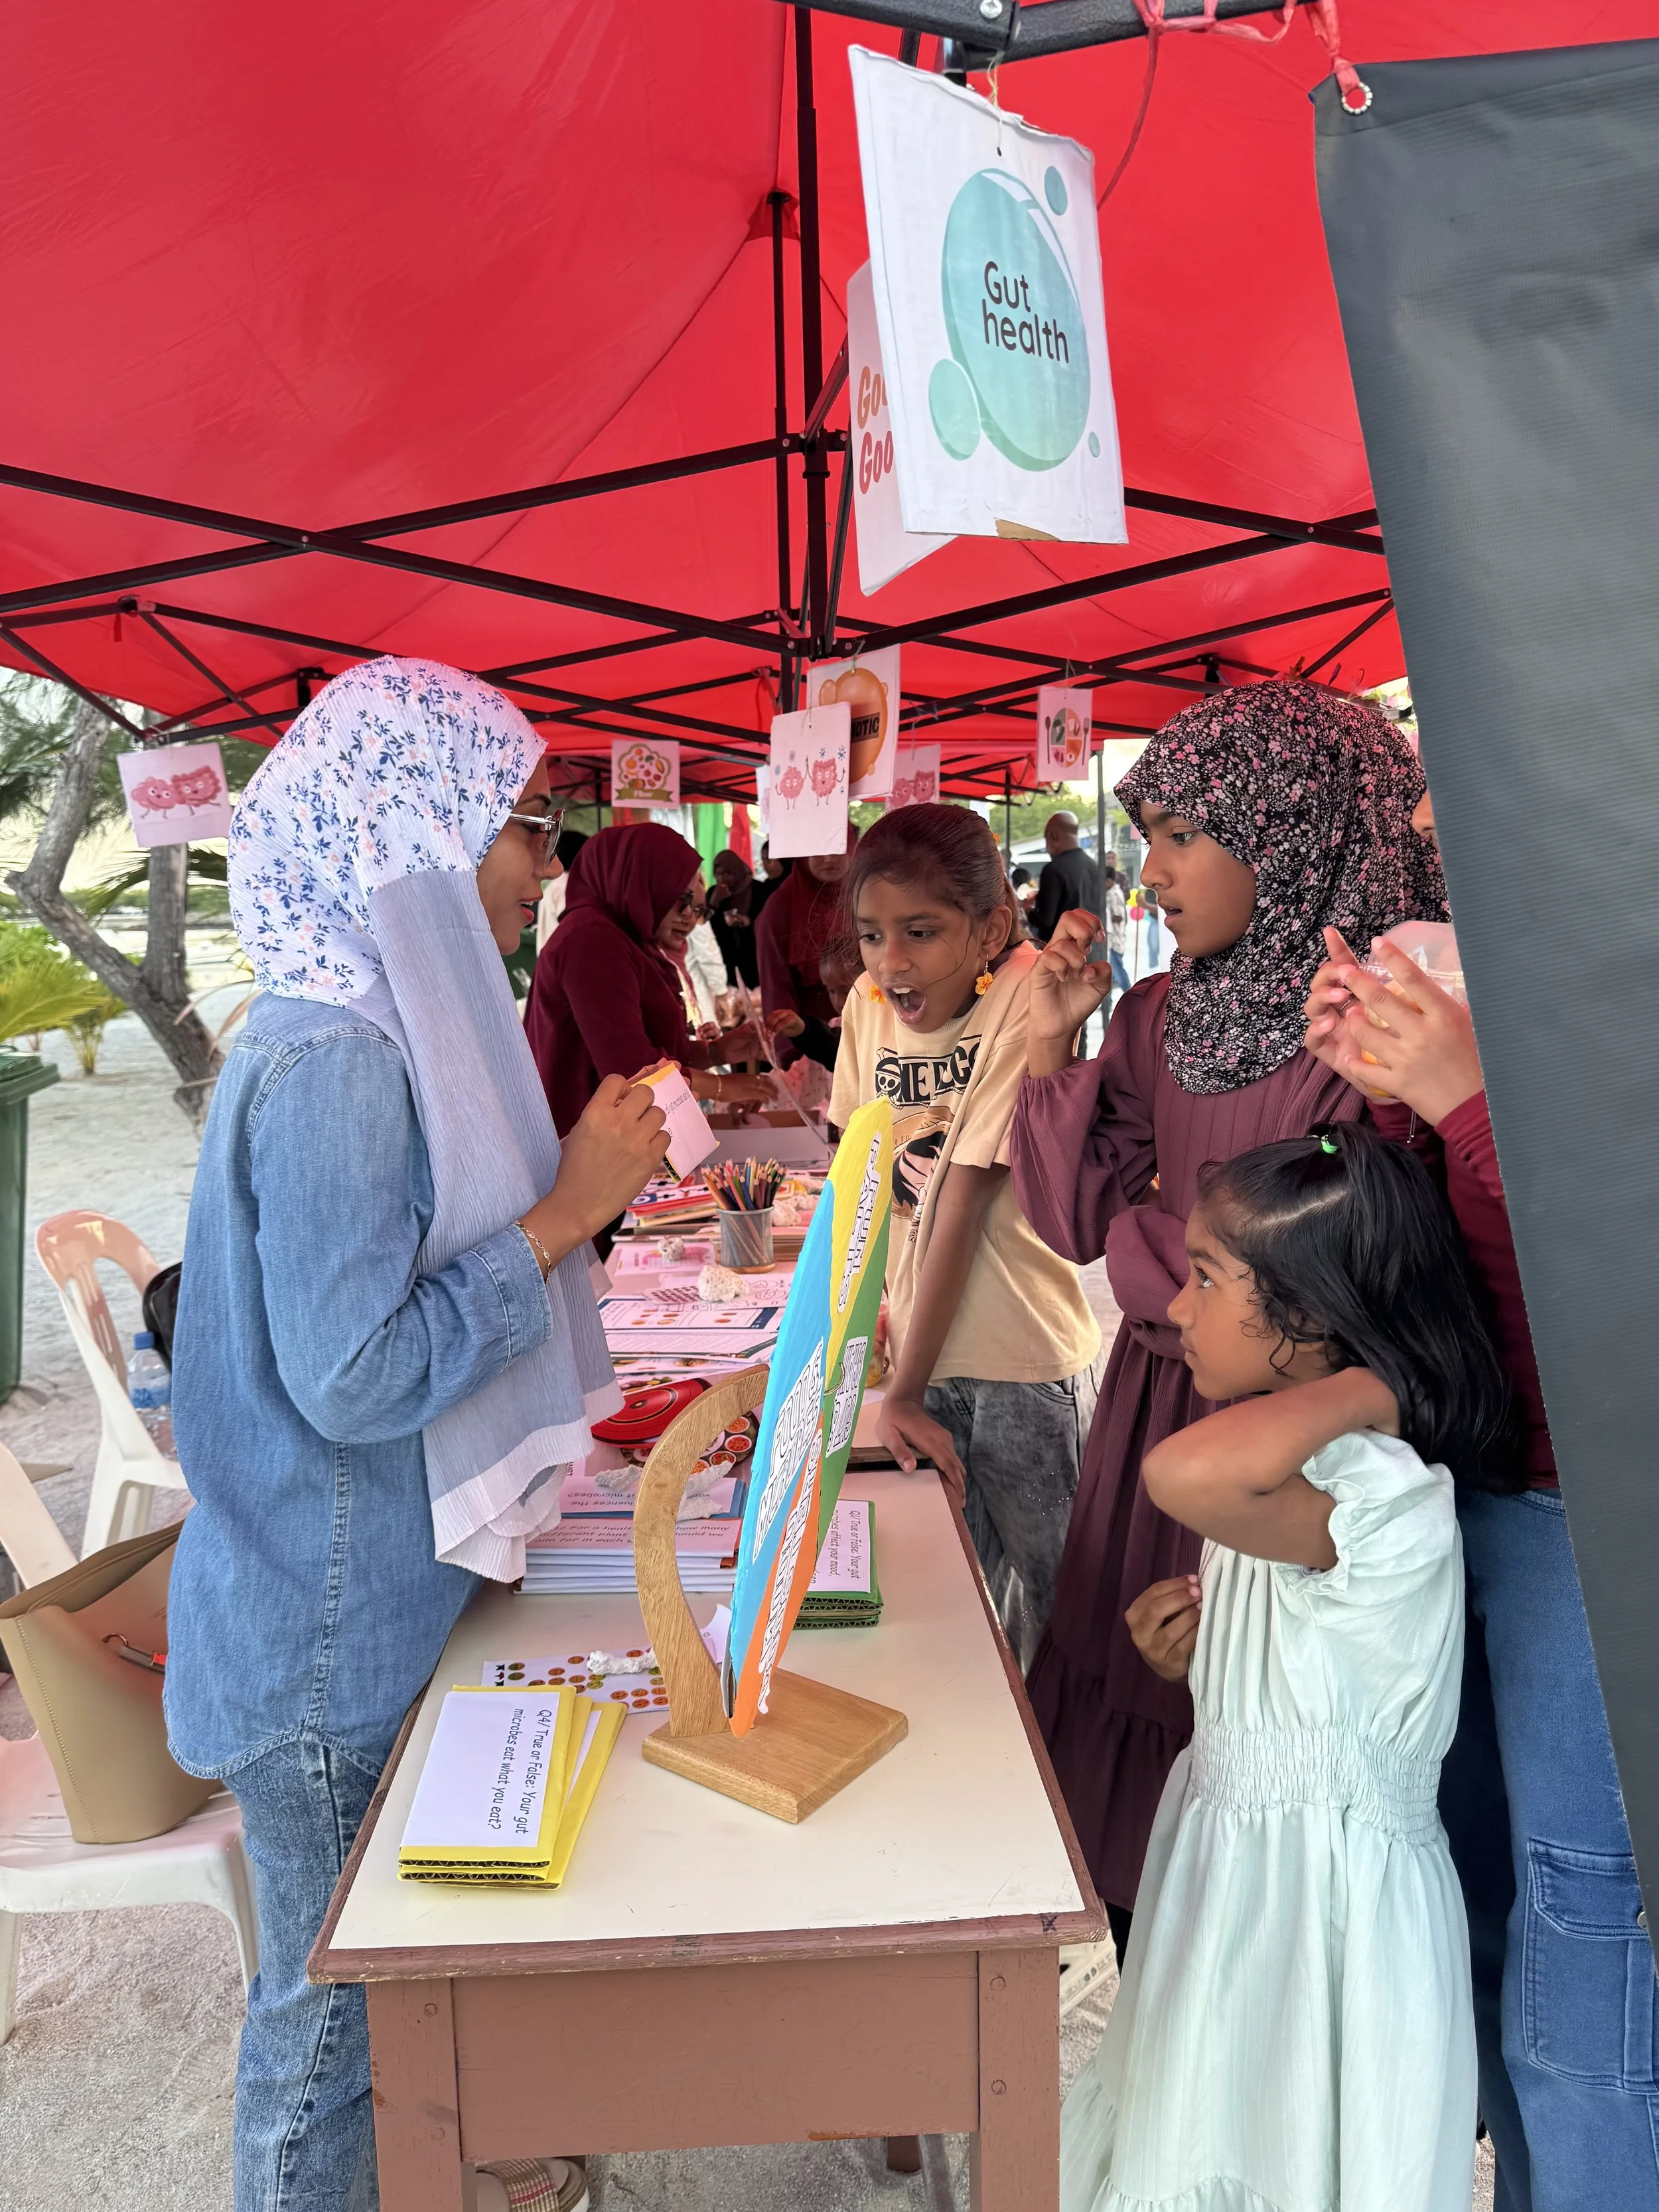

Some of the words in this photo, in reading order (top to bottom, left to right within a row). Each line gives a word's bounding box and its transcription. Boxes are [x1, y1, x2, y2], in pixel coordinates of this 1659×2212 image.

[983, 261, 1031, 313] Gut
[981, 299, 1069, 363] health
[839, 1140, 880, 1307] FACTS
[853, 1180, 879, 1268] FUN
[770, 1364, 810, 1479] FOOD
[754, 1396, 820, 1559] MICROBES
[851, 1520, 861, 1532] True
[831, 1530, 841, 1547] affect
[851, 1538, 861, 1554] False:
[828, 1548, 839, 1560] your
[851, 1555, 861, 1568] Your
[828, 1560, 841, 1577] mood,
[848, 1568, 861, 1580] gut
[507, 1708, 525, 1745] microbes
[536, 1709, 552, 1728] Q4/
[533, 1730, 548, 1749] True
[503, 1746, 516, 1760] eat
[531, 1750, 540, 1760] or
[498, 1762, 514, 1785] what
[525, 1762, 543, 1788] False:
[491, 1787, 506, 1805] you
[520, 1791, 537, 1814] Your
[488, 1806, 502, 1830] eat?
[513, 1816, 529, 1834] gut
